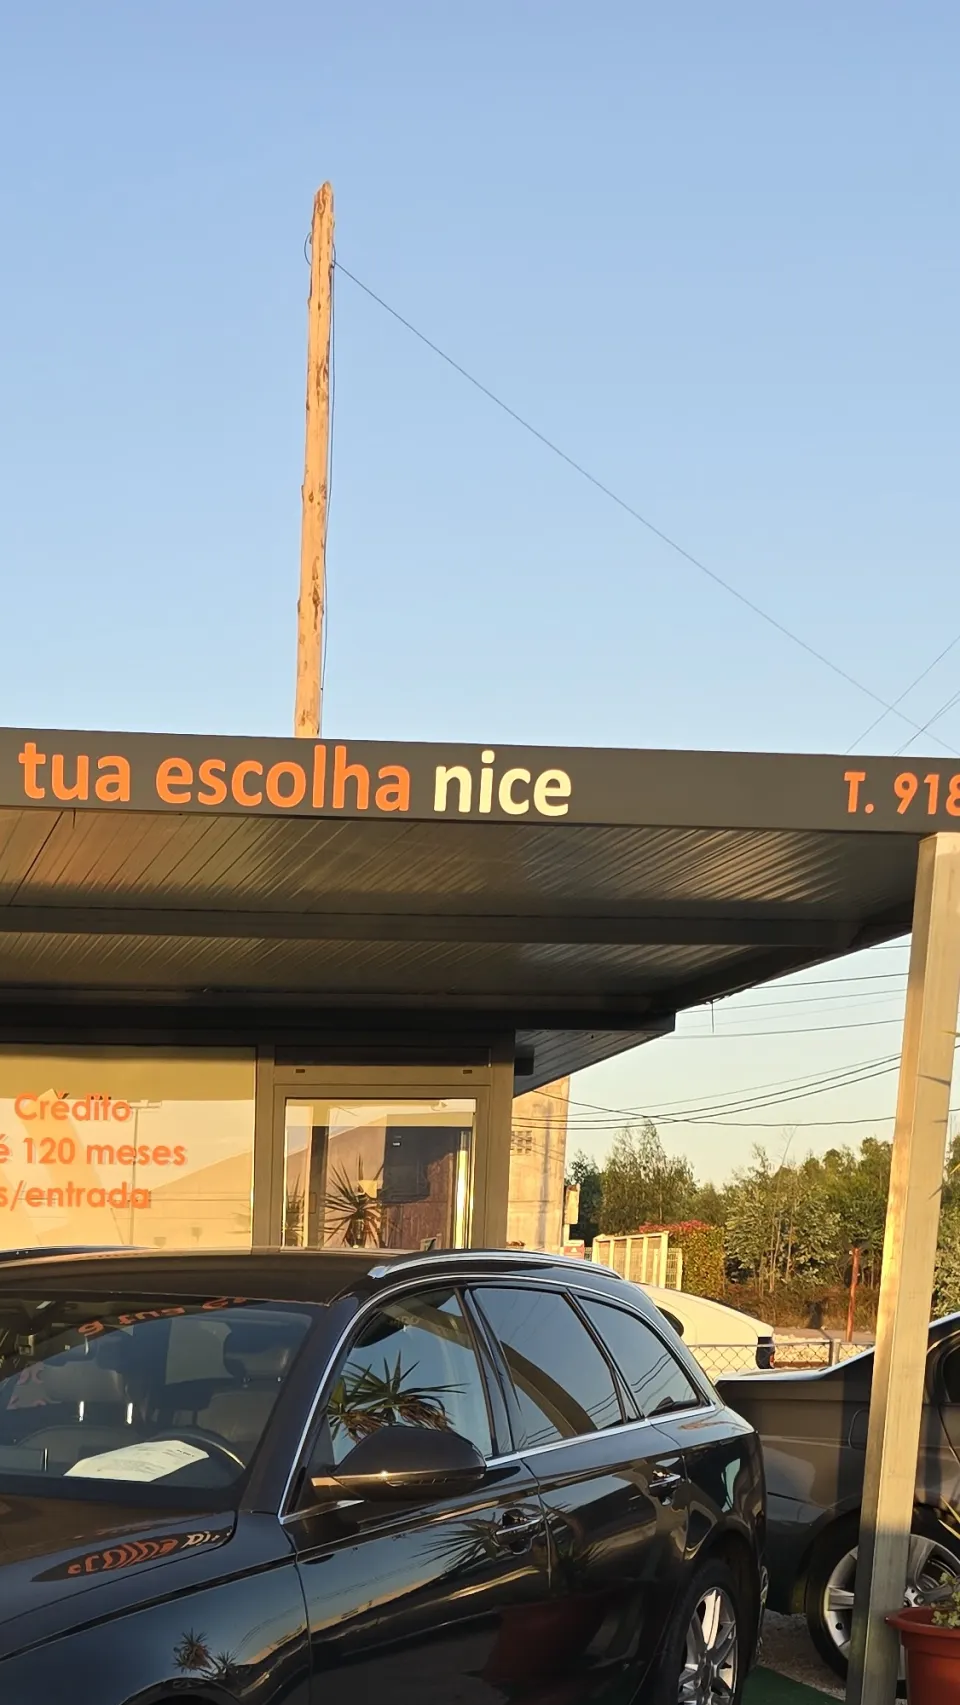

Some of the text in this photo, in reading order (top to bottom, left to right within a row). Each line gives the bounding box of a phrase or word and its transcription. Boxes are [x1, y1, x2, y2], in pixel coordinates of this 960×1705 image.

[18, 742, 131, 802] tua
[155, 745, 410, 812] escolha
[434, 750, 572, 816] nice
[843, 771, 875, 814] T.
[14, 1091, 132, 1122] Crédito
[22, 1137, 76, 1165] 120
[86, 1143, 187, 1166] meses
